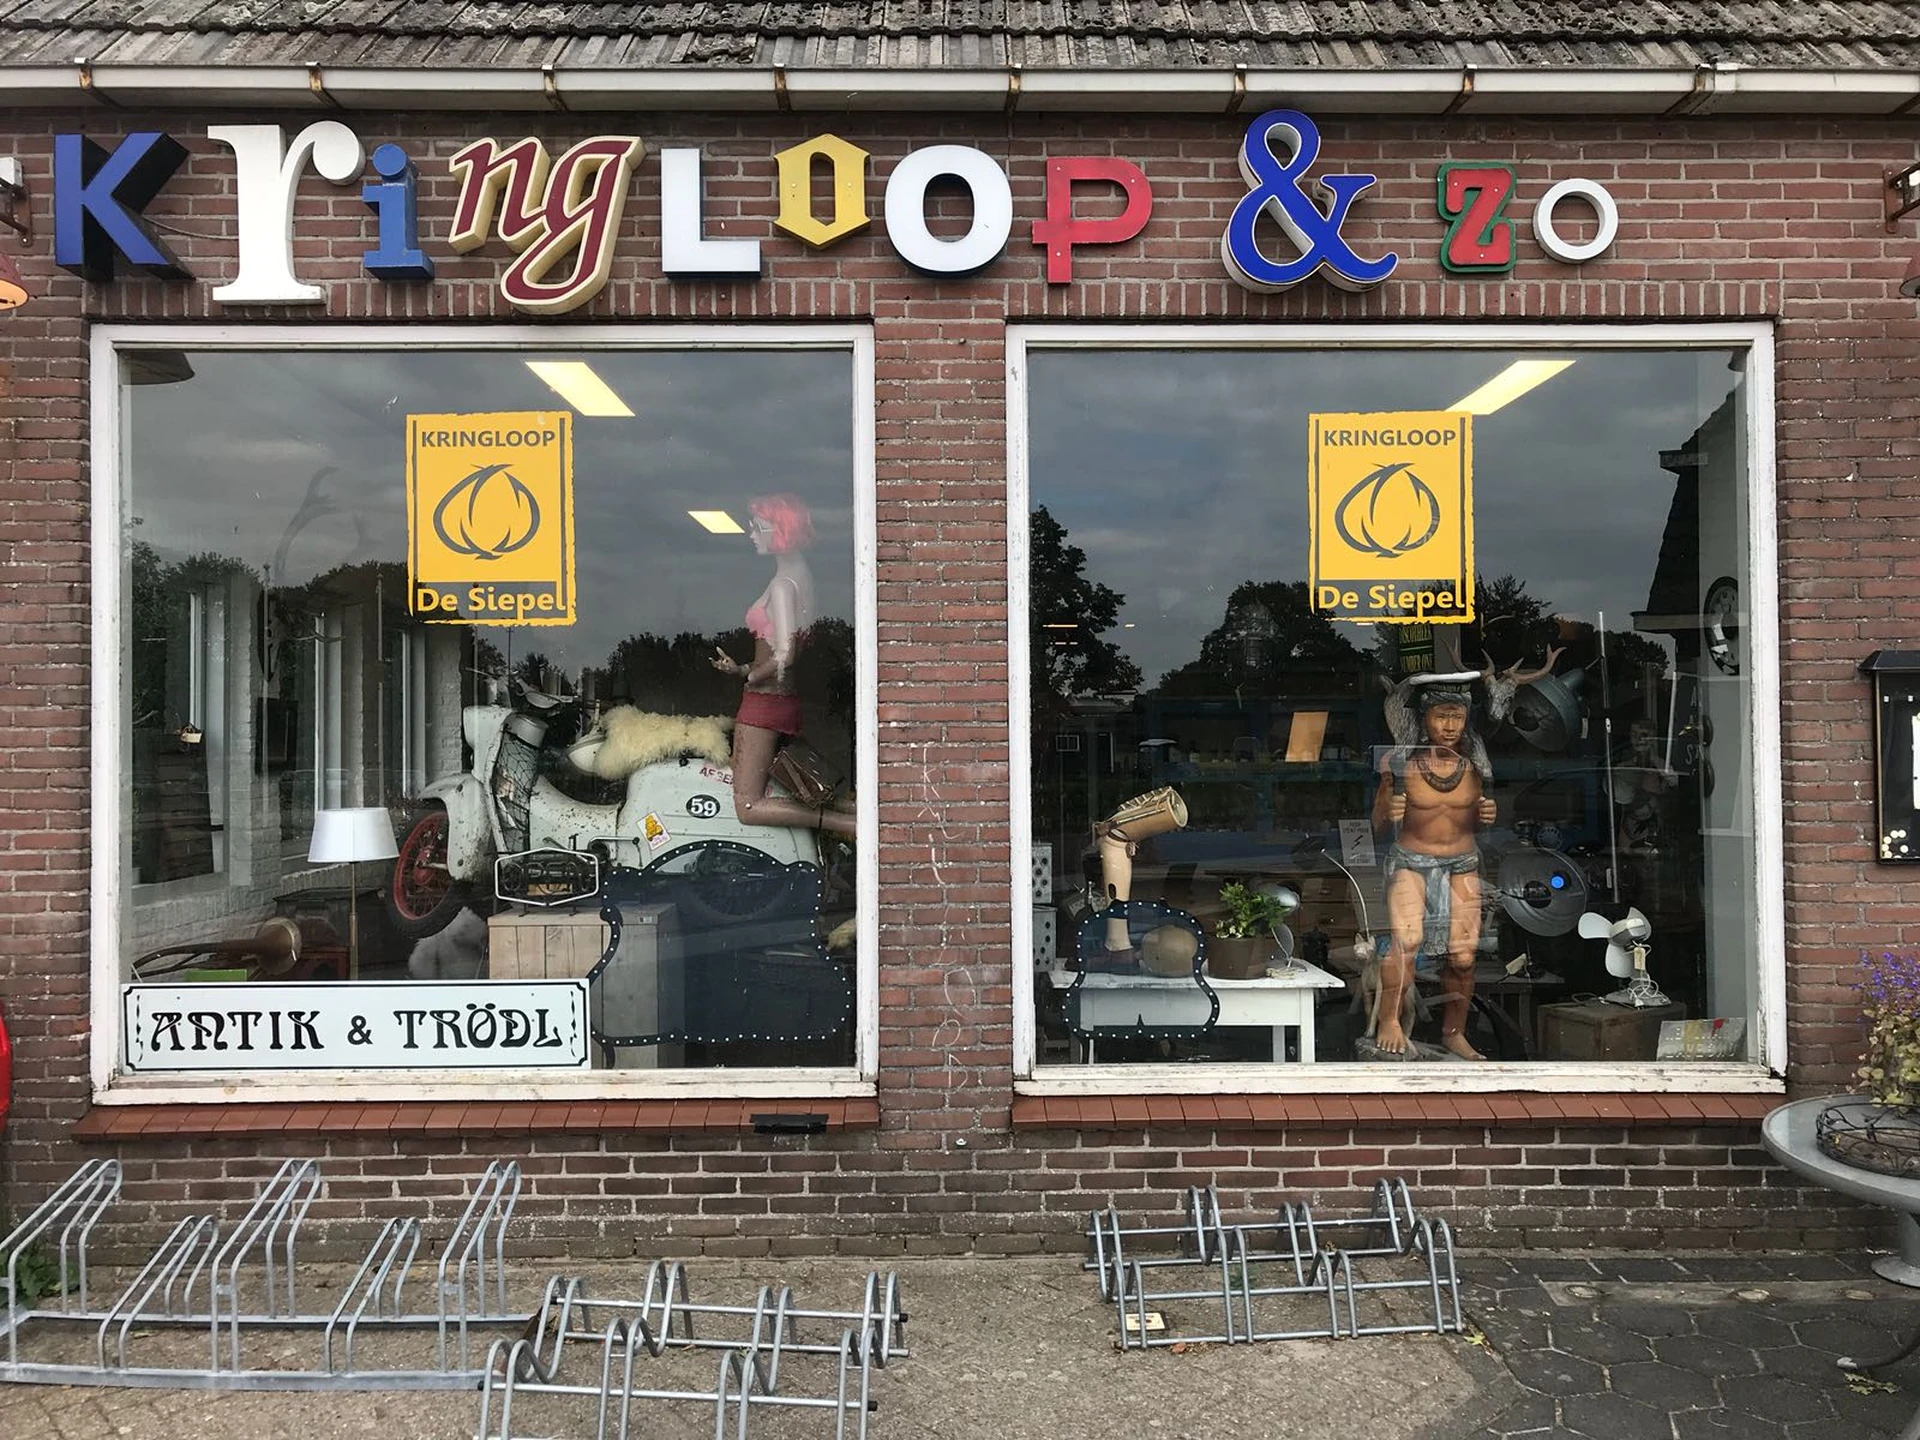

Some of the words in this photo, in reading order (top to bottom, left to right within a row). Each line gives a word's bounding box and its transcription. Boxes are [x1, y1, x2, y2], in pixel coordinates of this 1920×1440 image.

[1222, 109, 1399, 294] &
[421, 429, 556, 448] KRINGLOOP
[1323, 429, 1457, 447] KRINGLOOP
[416, 588, 458, 612] De
[468, 585, 566, 619] Siepel
[1317, 585, 1360, 609] De
[1368, 583, 1465, 617] Siepel
[691, 798, 717, 816] 59
[150, 1010, 325, 1052] ANTIK
[346, 1014, 373, 1046] &
[392, 1002, 564, 1049] TRÖDL
